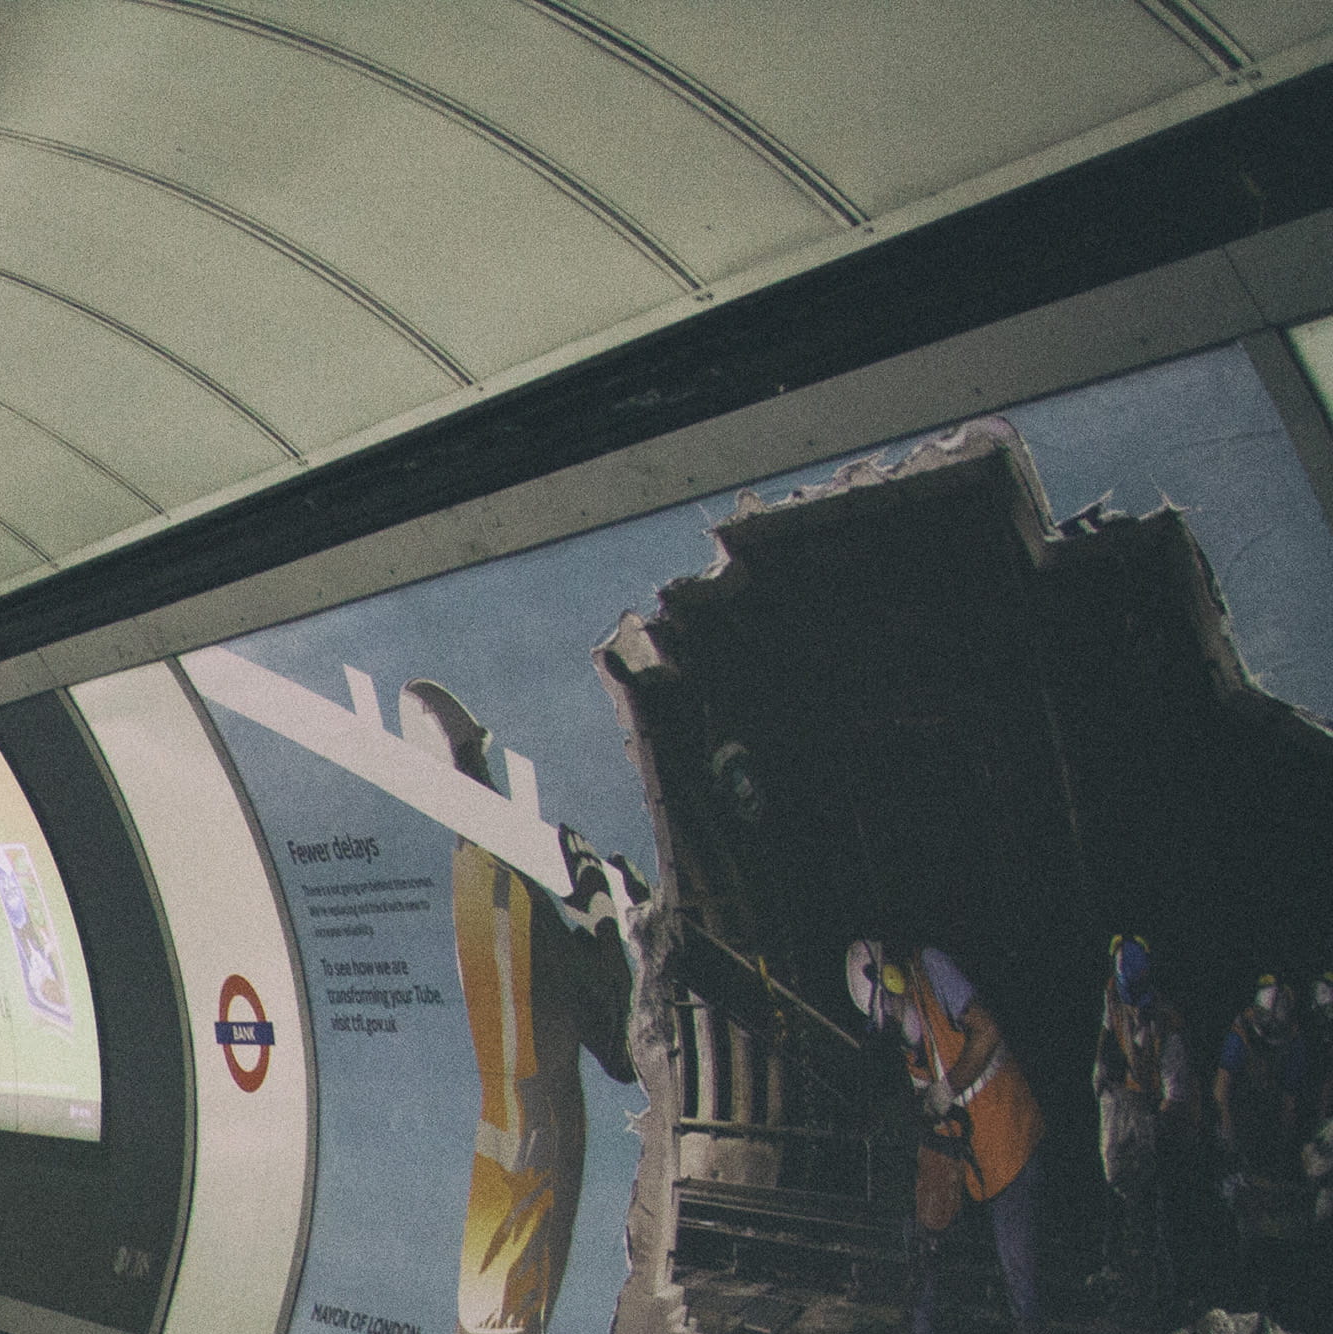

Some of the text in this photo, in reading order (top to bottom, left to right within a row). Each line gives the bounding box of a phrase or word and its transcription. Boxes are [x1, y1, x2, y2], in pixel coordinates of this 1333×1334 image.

[287, 832, 380, 866] Fewer delays
[320, 957, 409, 976] To see how we are
[327, 985, 391, 1010] transforming
[389, 988, 414, 1009] your
[232, 1024, 256, 1041] BANK
[331, 1013, 399, 1036] visit tfl.gov.uk
[311, 1303, 351, 1330] MAYOR
[350, 1312, 368, 1333] OF
